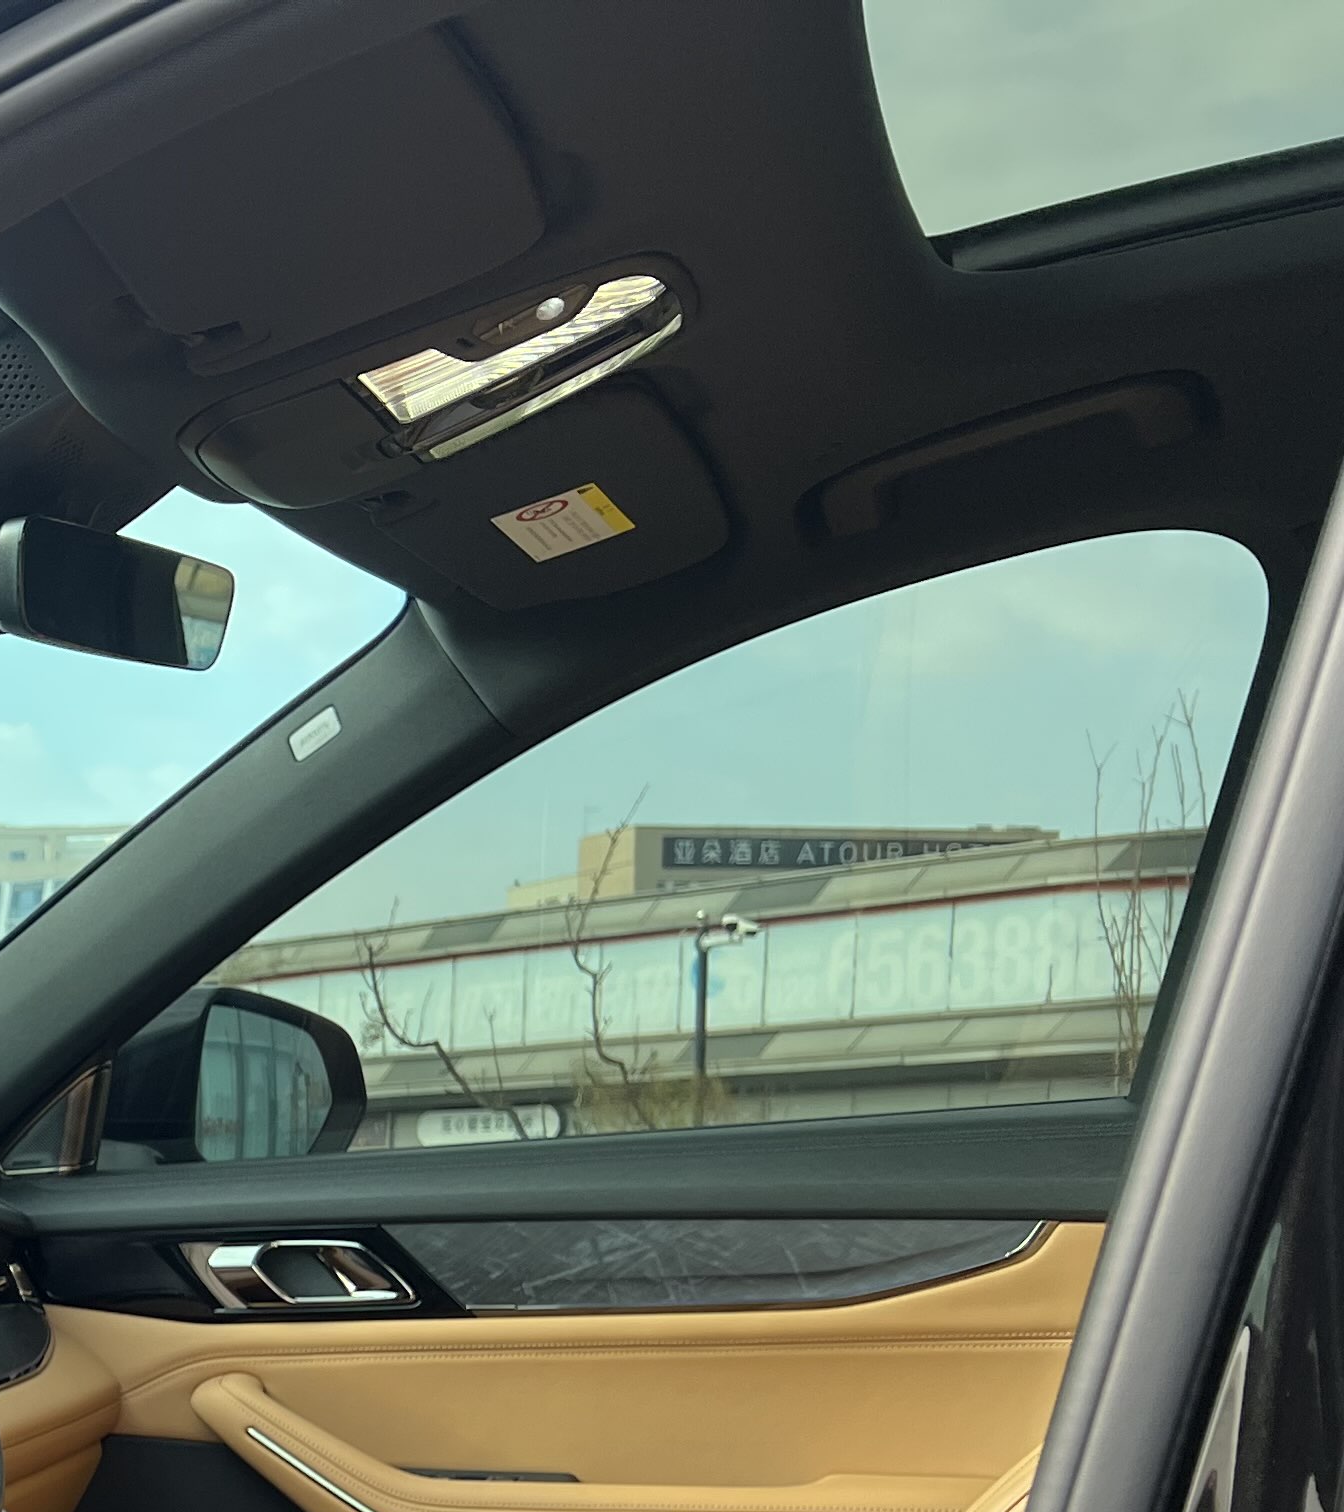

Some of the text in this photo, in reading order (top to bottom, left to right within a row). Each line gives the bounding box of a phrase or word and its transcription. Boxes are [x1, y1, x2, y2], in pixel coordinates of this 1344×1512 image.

[673, 838, 782, 866] 亚朵酒店
[796, 840, 904, 866] ATOUR
